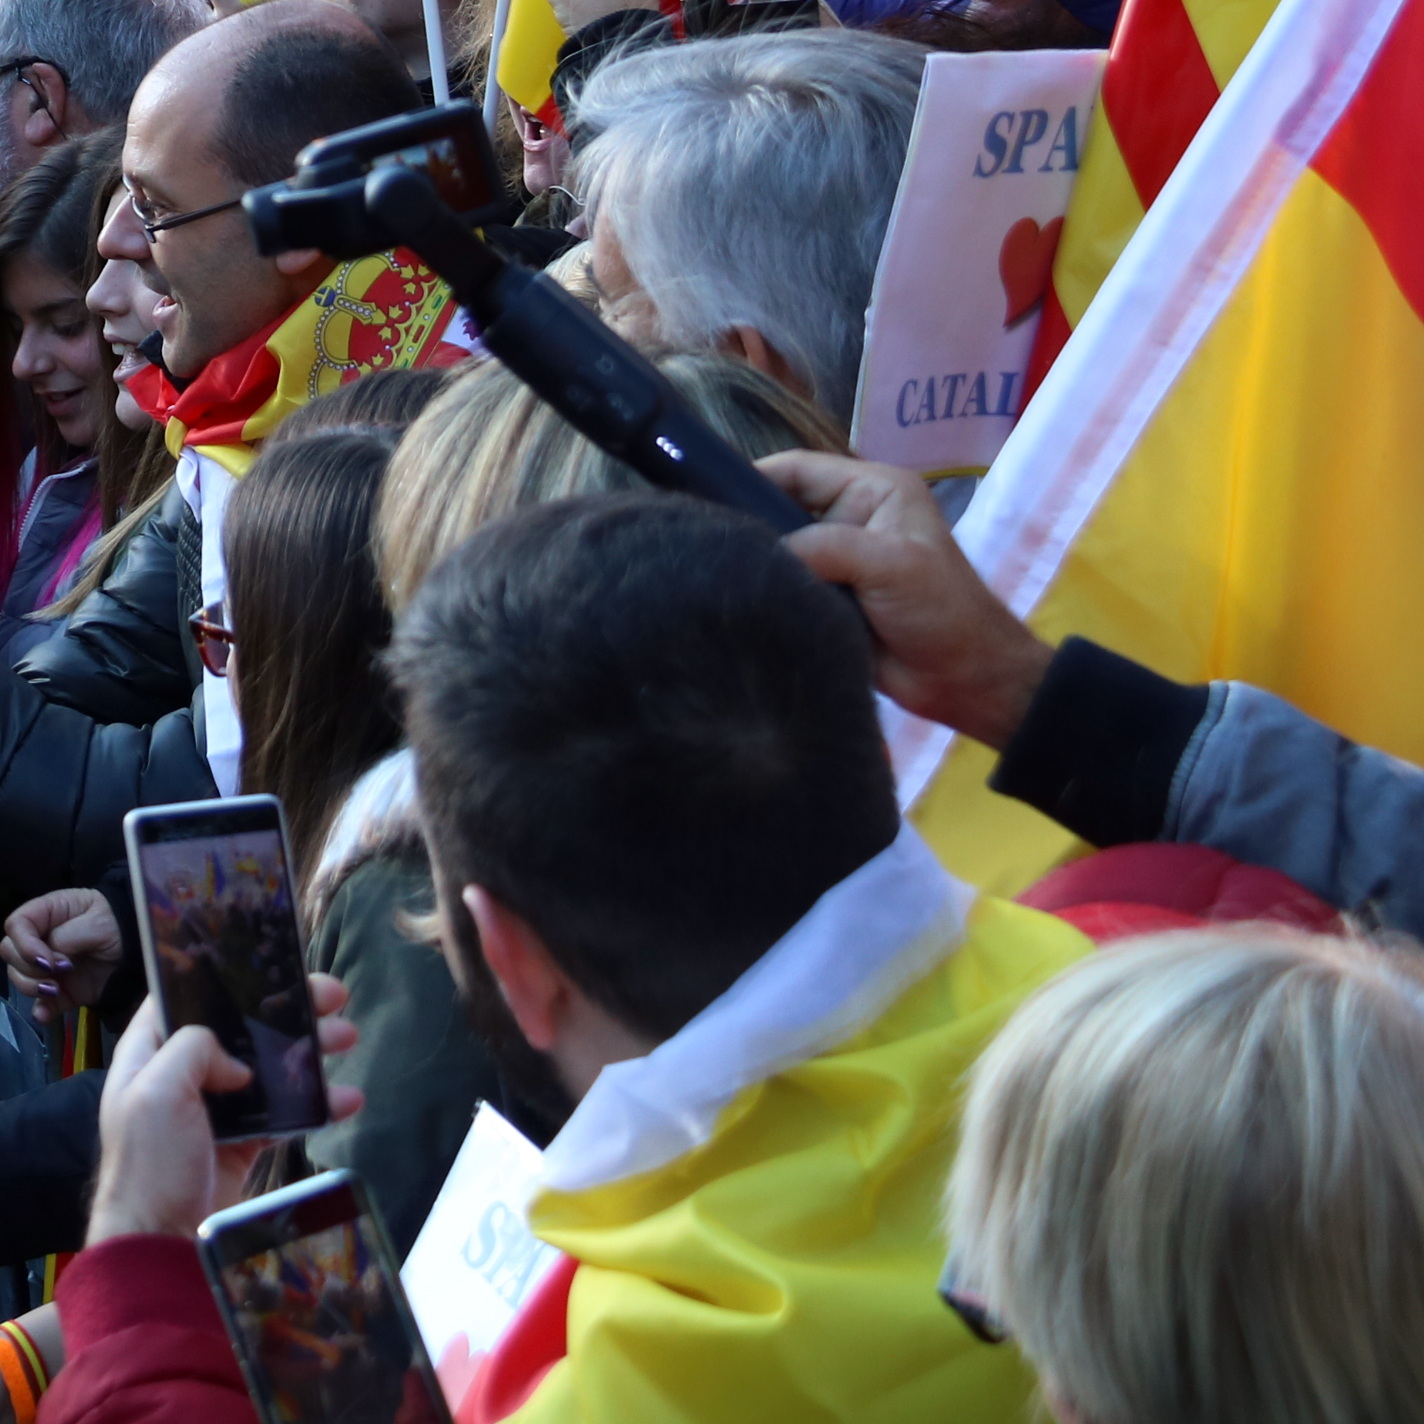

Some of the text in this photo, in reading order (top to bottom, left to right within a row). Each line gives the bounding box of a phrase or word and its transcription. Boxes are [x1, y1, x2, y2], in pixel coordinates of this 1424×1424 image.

[973, 105, 1094, 179] SPA
[895, 371, 1020, 429] CATAL
[459, 1199, 548, 1311] SPA
